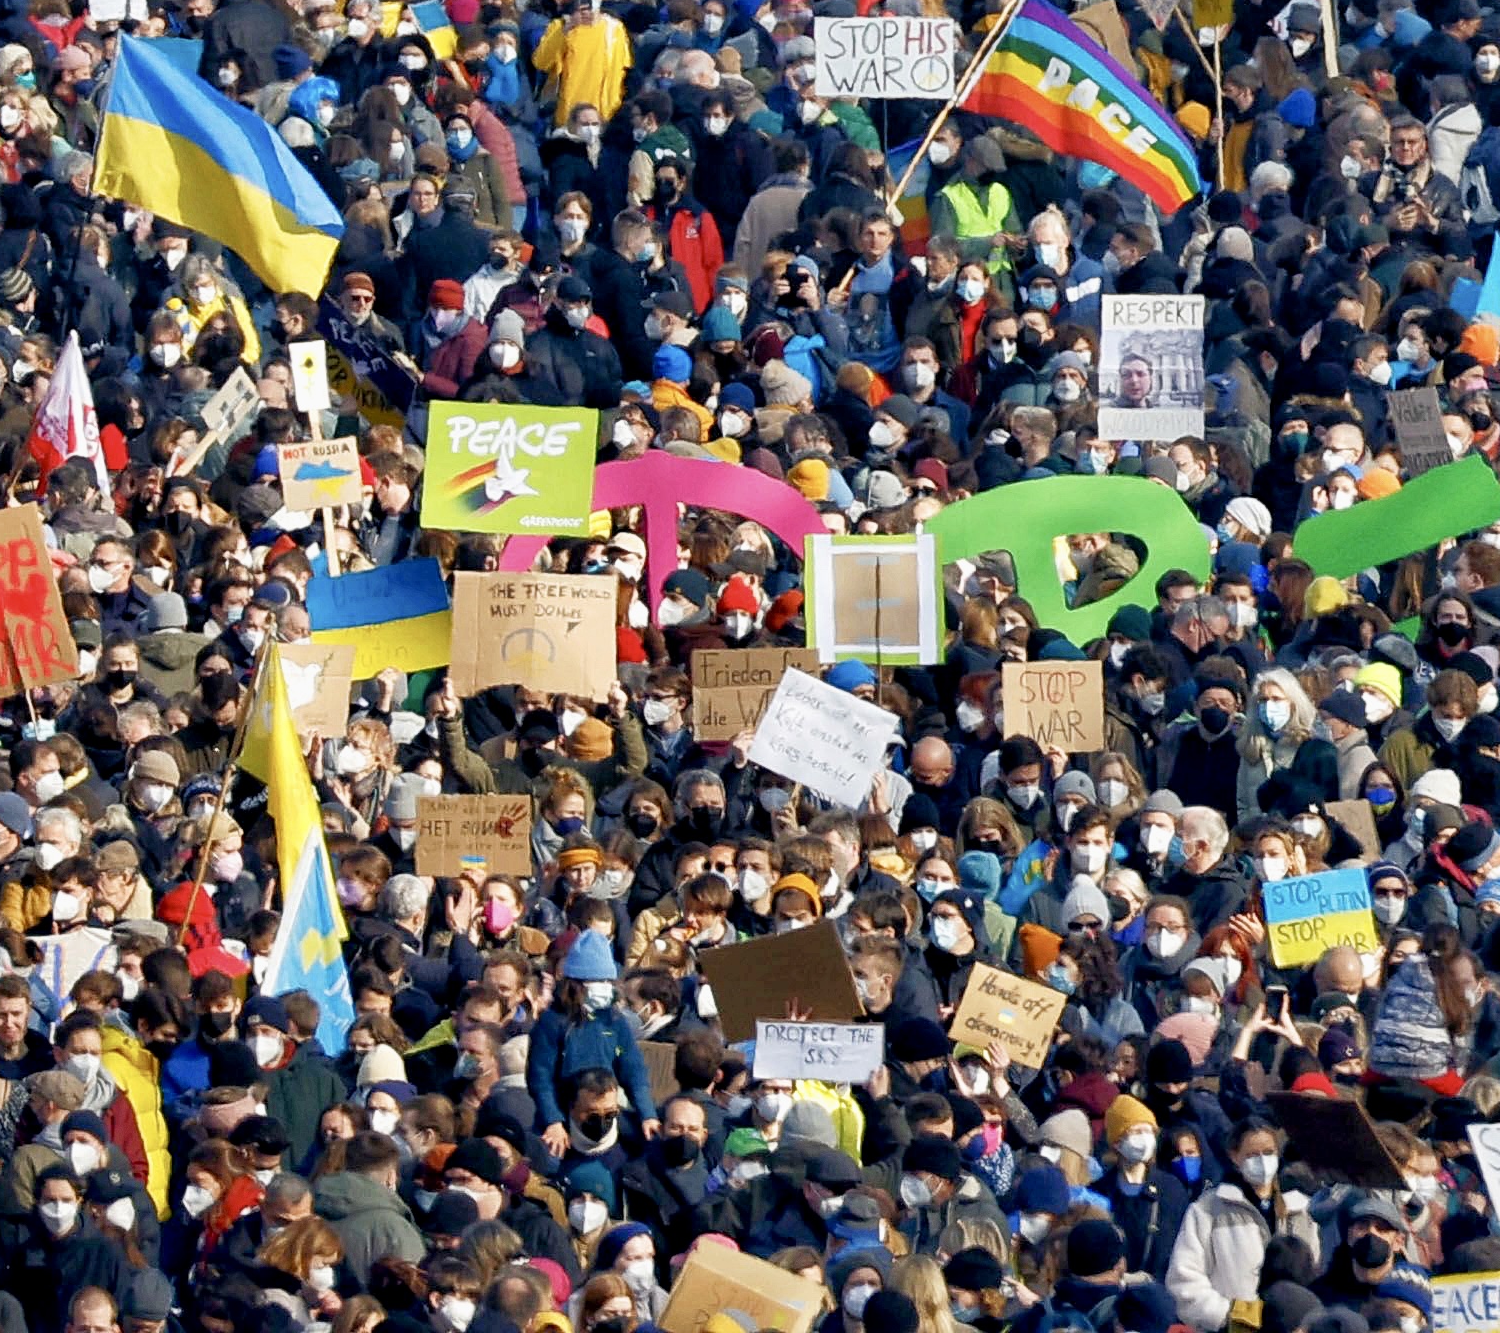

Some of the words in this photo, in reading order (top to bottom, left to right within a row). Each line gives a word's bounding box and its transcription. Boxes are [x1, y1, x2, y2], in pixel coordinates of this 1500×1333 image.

[825, 19, 899, 60] STOP
[904, 19, 950, 55] HIS
[825, 55, 906, 94] WAR
[1040, 56, 1159, 153] PACE
[1112, 300, 1200, 326] RESPEKT
[446, 416, 580, 457] PEACE
[489, 583, 515, 600] THE
[490, 603, 527, 620] MUST
[701, 653, 771, 688] Frieden
[1020, 671, 1087, 705] STOP
[702, 705, 727, 727] die
[1026, 710, 1087, 745] WAR
[1272, 879, 1321, 906] STOP
[1319, 889, 1367, 914] PUTIN
[1277, 918, 1326, 945] STOP
[977, 975, 1020, 1005] Hands
[1023, 999, 1055, 1020] off
[763, 1024, 835, 1044] PROTECT
[850, 1027, 875, 1043] THE
[805, 1048, 841, 1065] SKY
[1432, 1283, 1498, 1329] EACE
